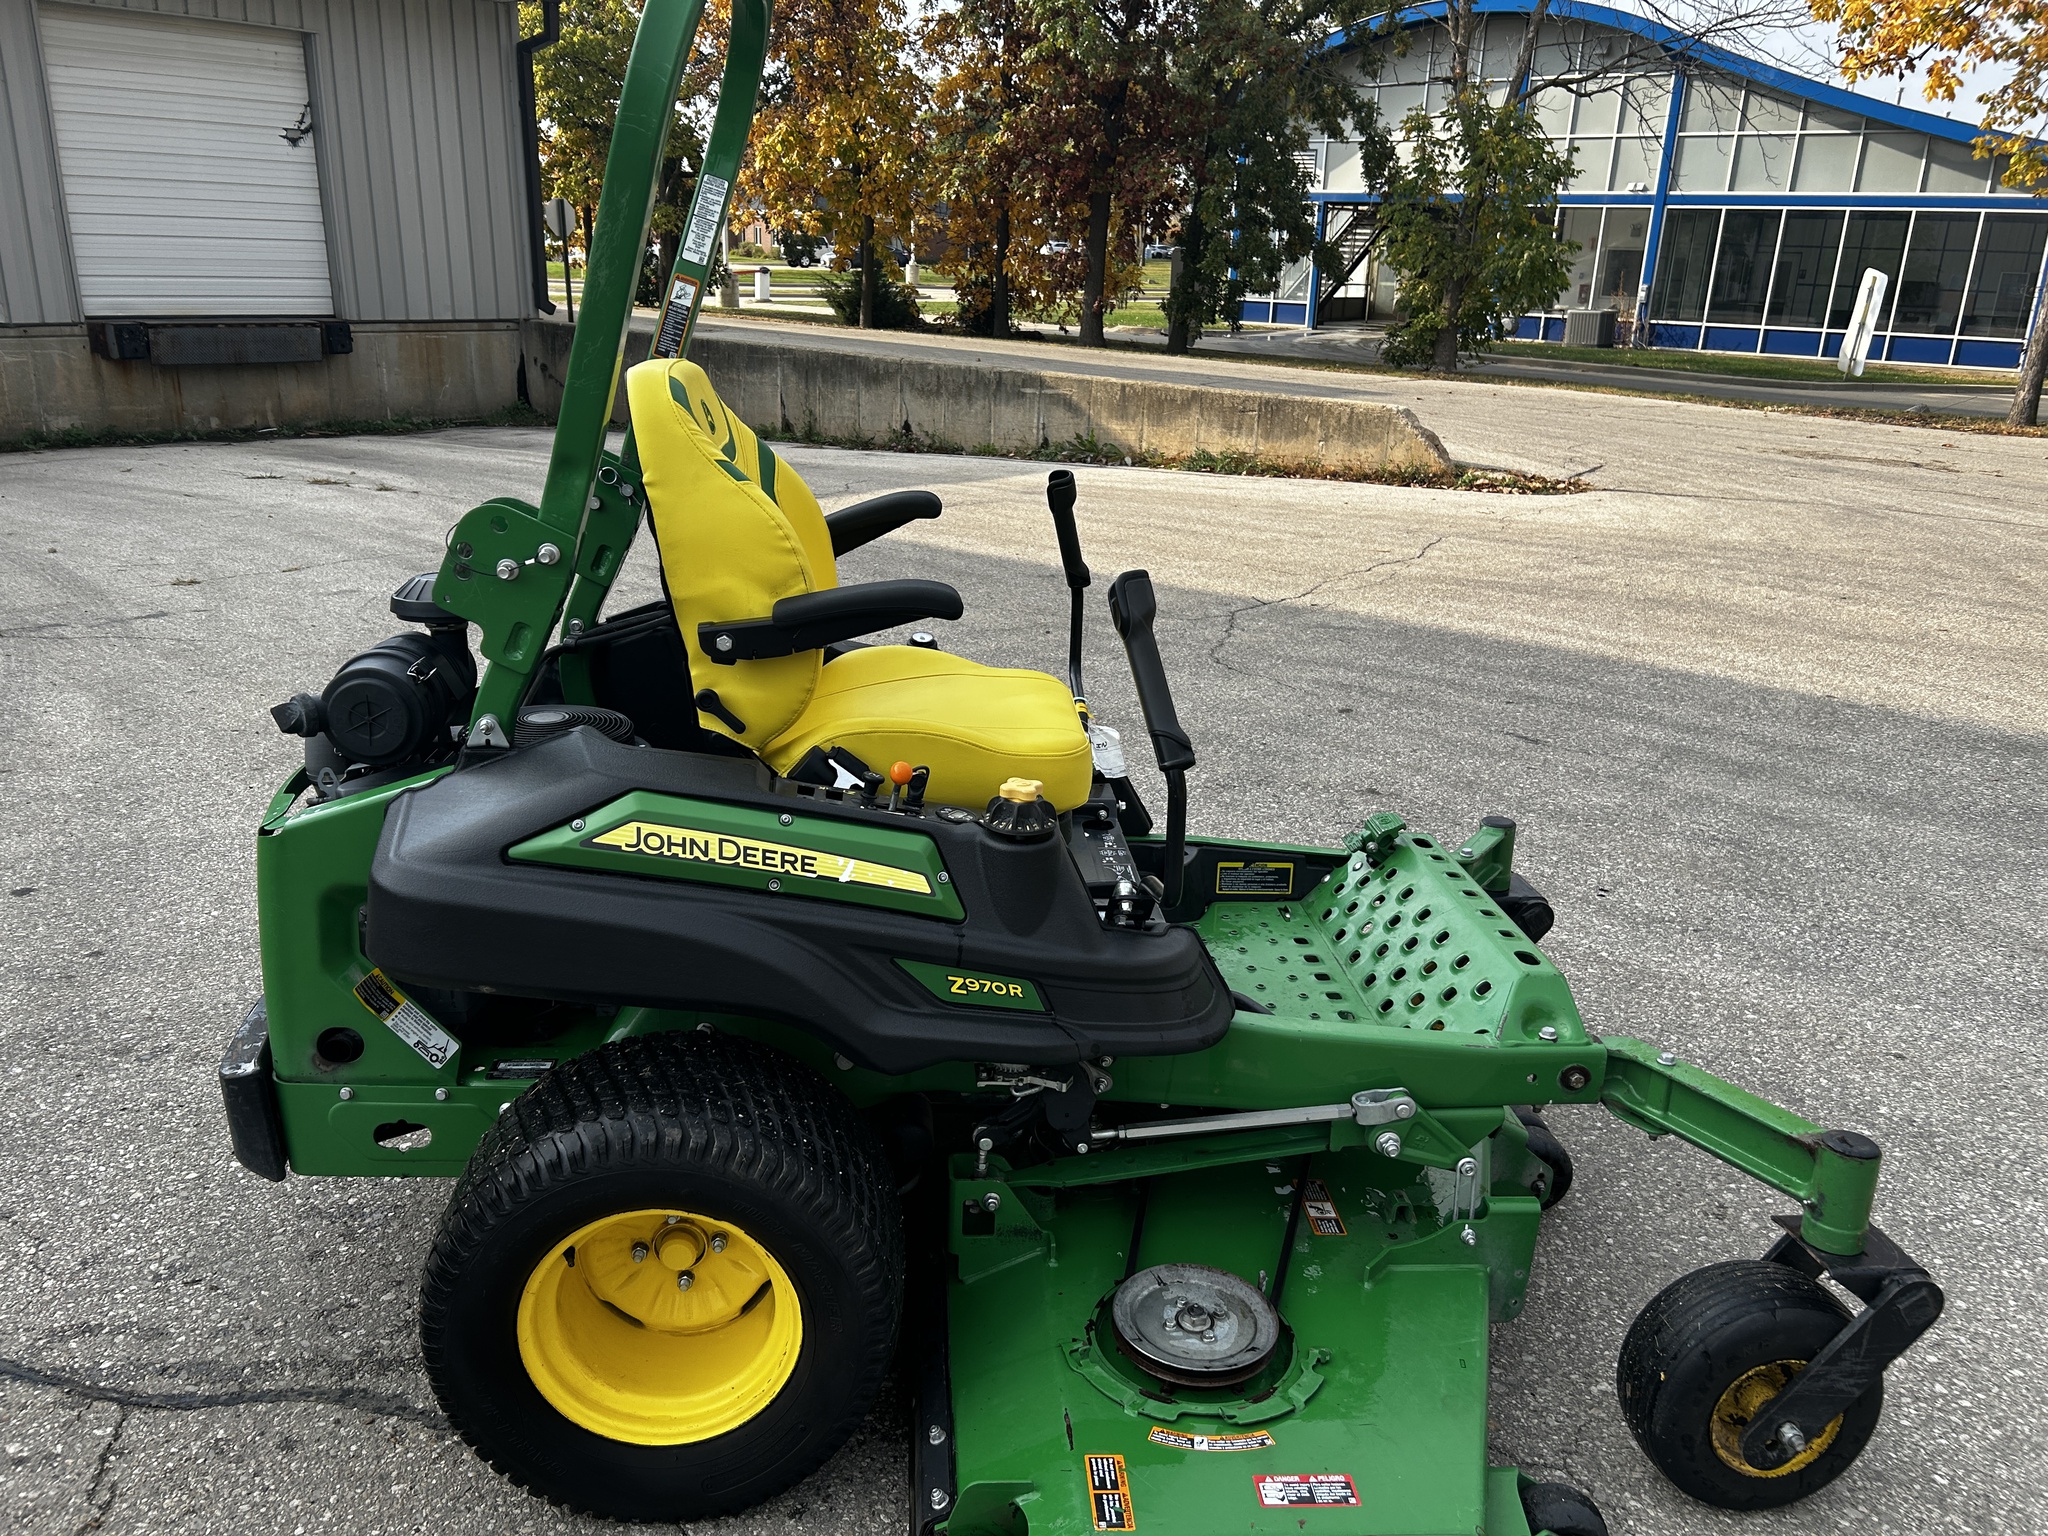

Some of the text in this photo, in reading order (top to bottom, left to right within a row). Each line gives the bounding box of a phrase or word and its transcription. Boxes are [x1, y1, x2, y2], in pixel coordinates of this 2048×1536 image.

[625, 826, 818, 875] JOHN DEERE
[377, 974, 395, 995] CAUTION
[947, 975, 1024, 998] Z970R
